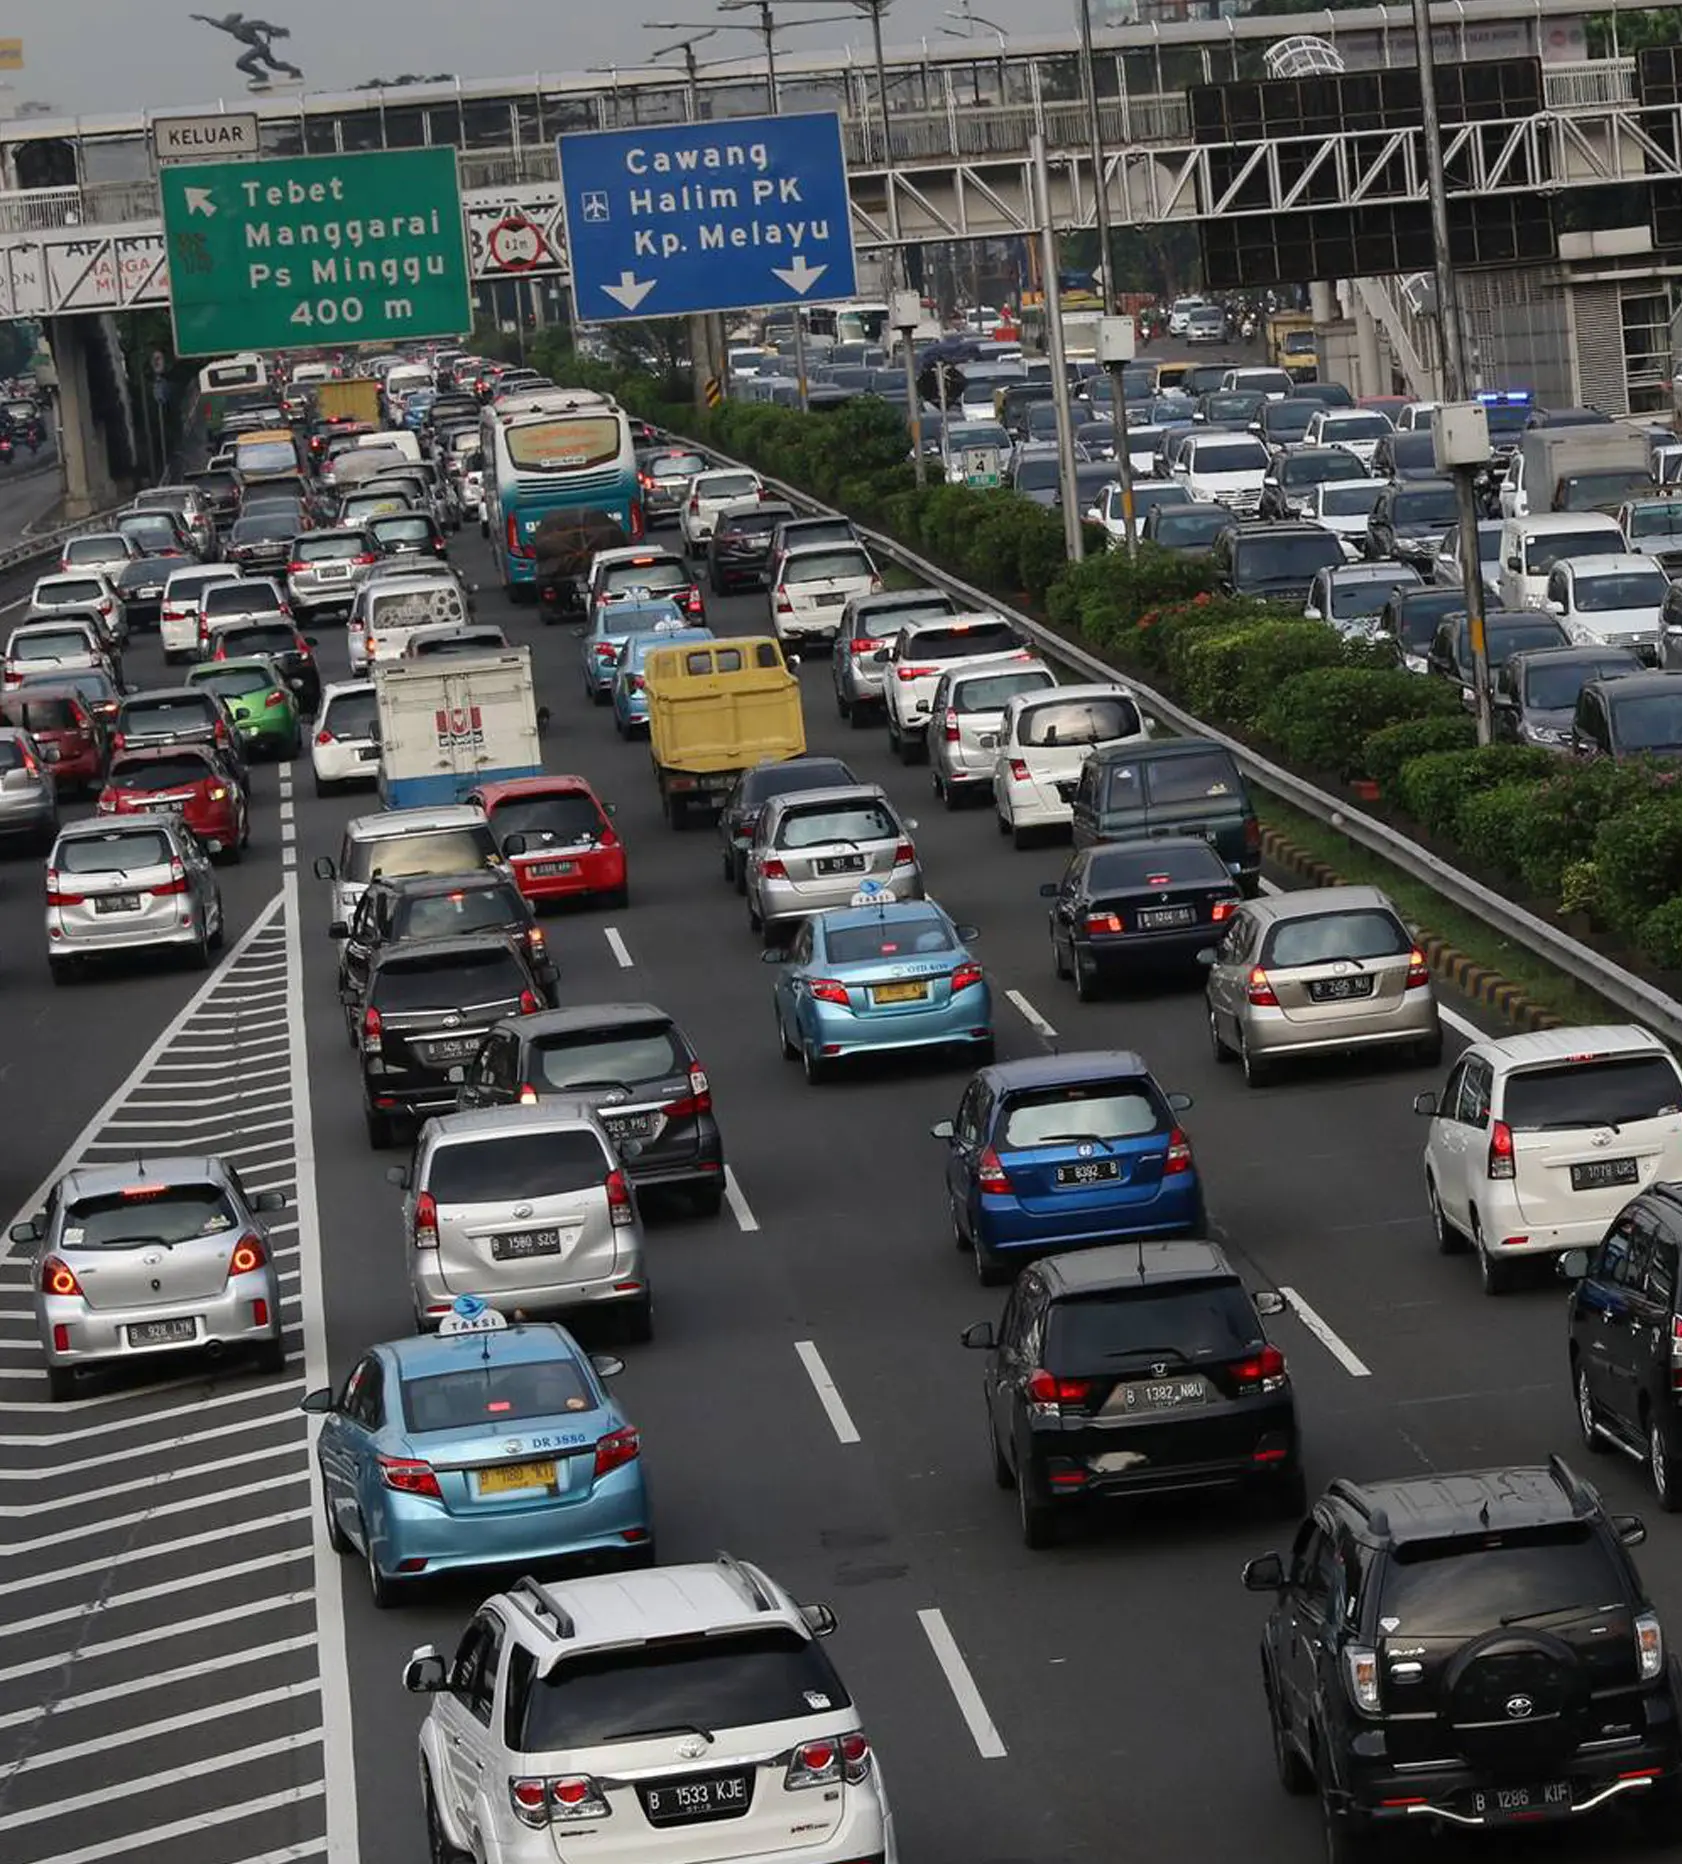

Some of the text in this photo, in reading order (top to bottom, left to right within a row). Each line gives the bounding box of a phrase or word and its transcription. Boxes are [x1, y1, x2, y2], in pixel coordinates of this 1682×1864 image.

[168, 126, 244, 146] KELUAR
[626, 143, 767, 175] Cawang
[241, 176, 344, 207] Tebet
[629, 176, 803, 216] Halim PK
[244, 209, 440, 250] Manggarai
[634, 218, 829, 258] Kp. Melayu
[249, 255, 445, 289] Ps Minggu
[290, 296, 413, 327] 400 m
[976, 460, 985, 472] 4
[1057, 1168, 1064, 1180] B
[493, 1238, 500, 1251] B
[129, 1328, 138, 1340] B
[451, 1317, 497, 1331] TAKSI
[1126, 1390, 1136, 1404] B
[1145, 1385, 1173, 1401] 1382
[649, 1778, 744, 1810] B 1533 KJE
[1475, 1793, 1485, 1811] B
[1497, 1788, 1530, 1808] 1286
